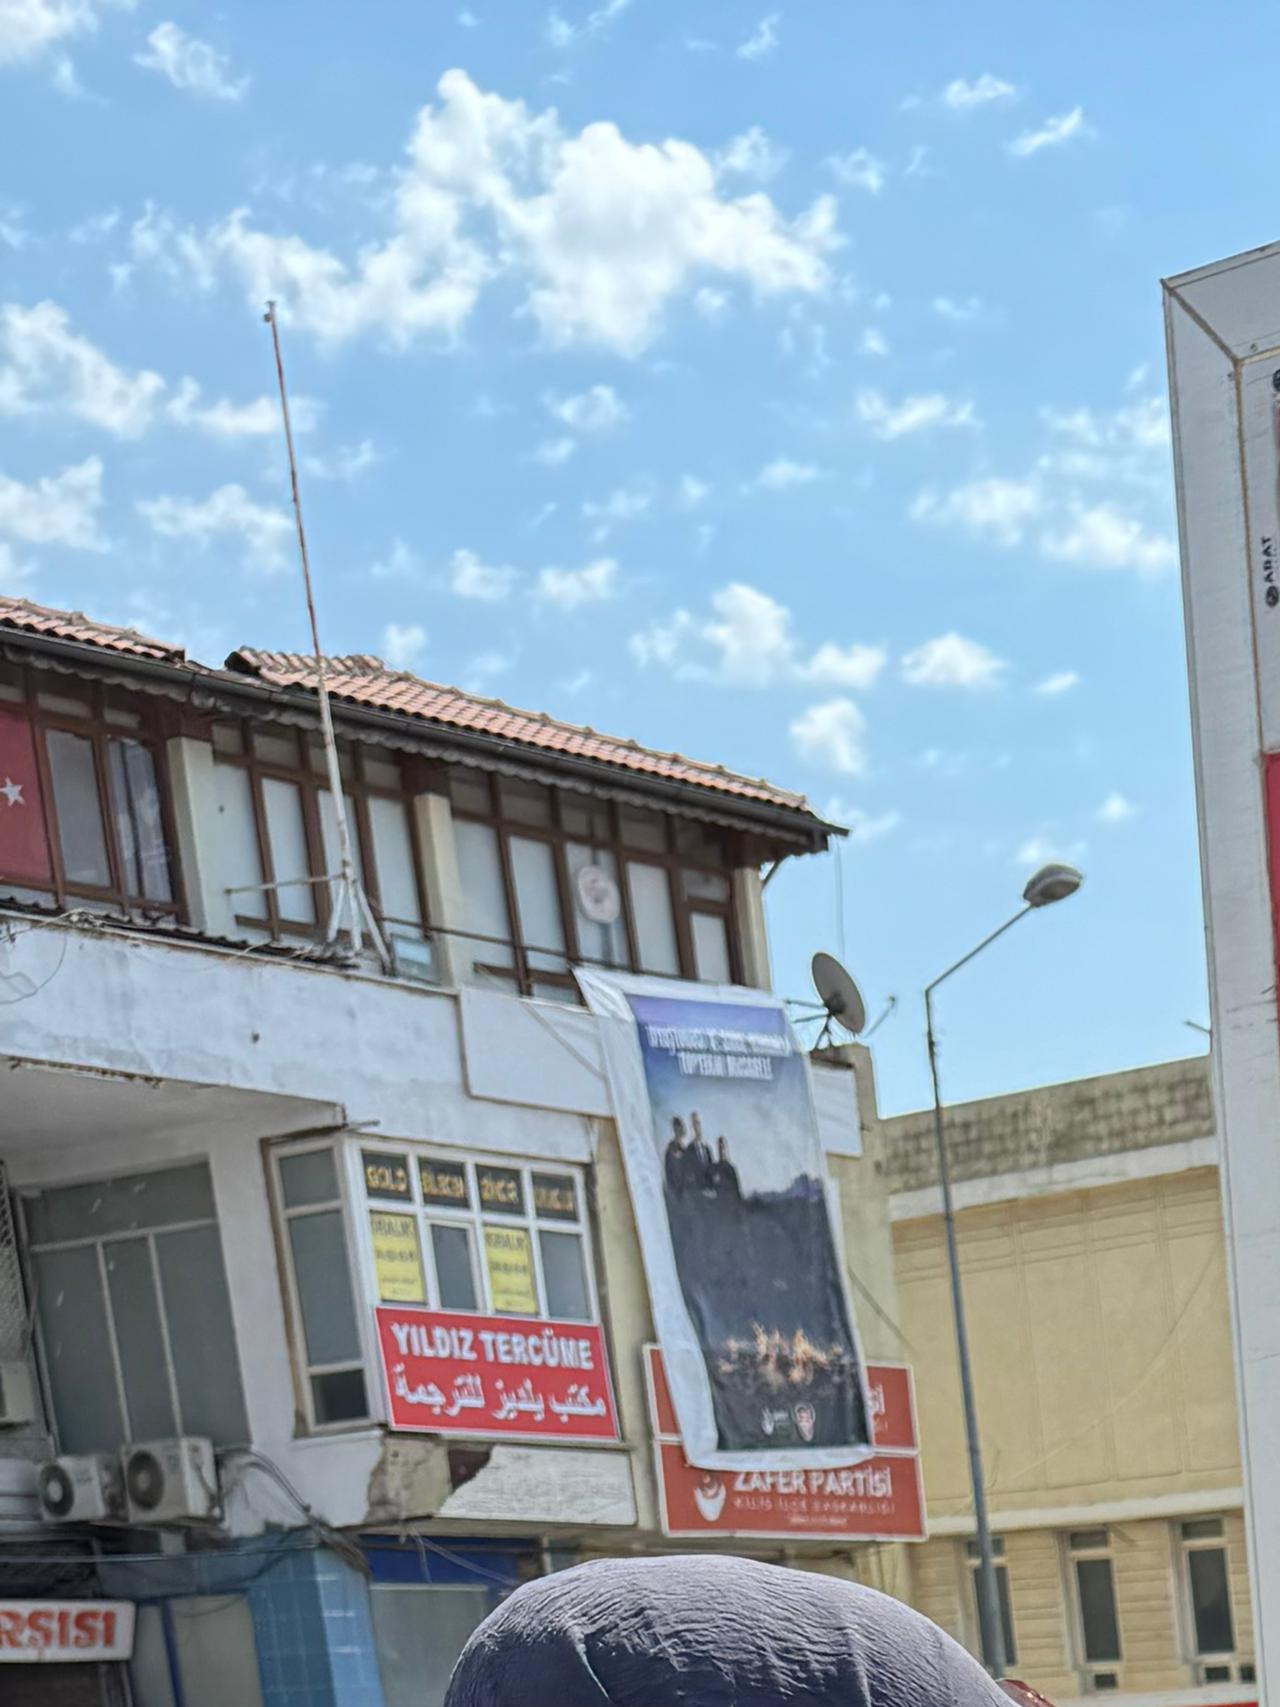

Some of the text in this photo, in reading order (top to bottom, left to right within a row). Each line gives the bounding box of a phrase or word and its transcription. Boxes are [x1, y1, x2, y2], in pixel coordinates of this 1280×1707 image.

[1261, 536, 1274, 583] ARAT
[390, 1322, 594, 1370] YILDIZ TERCÜME
[809, 1466, 892, 1498] PARTİSİ
